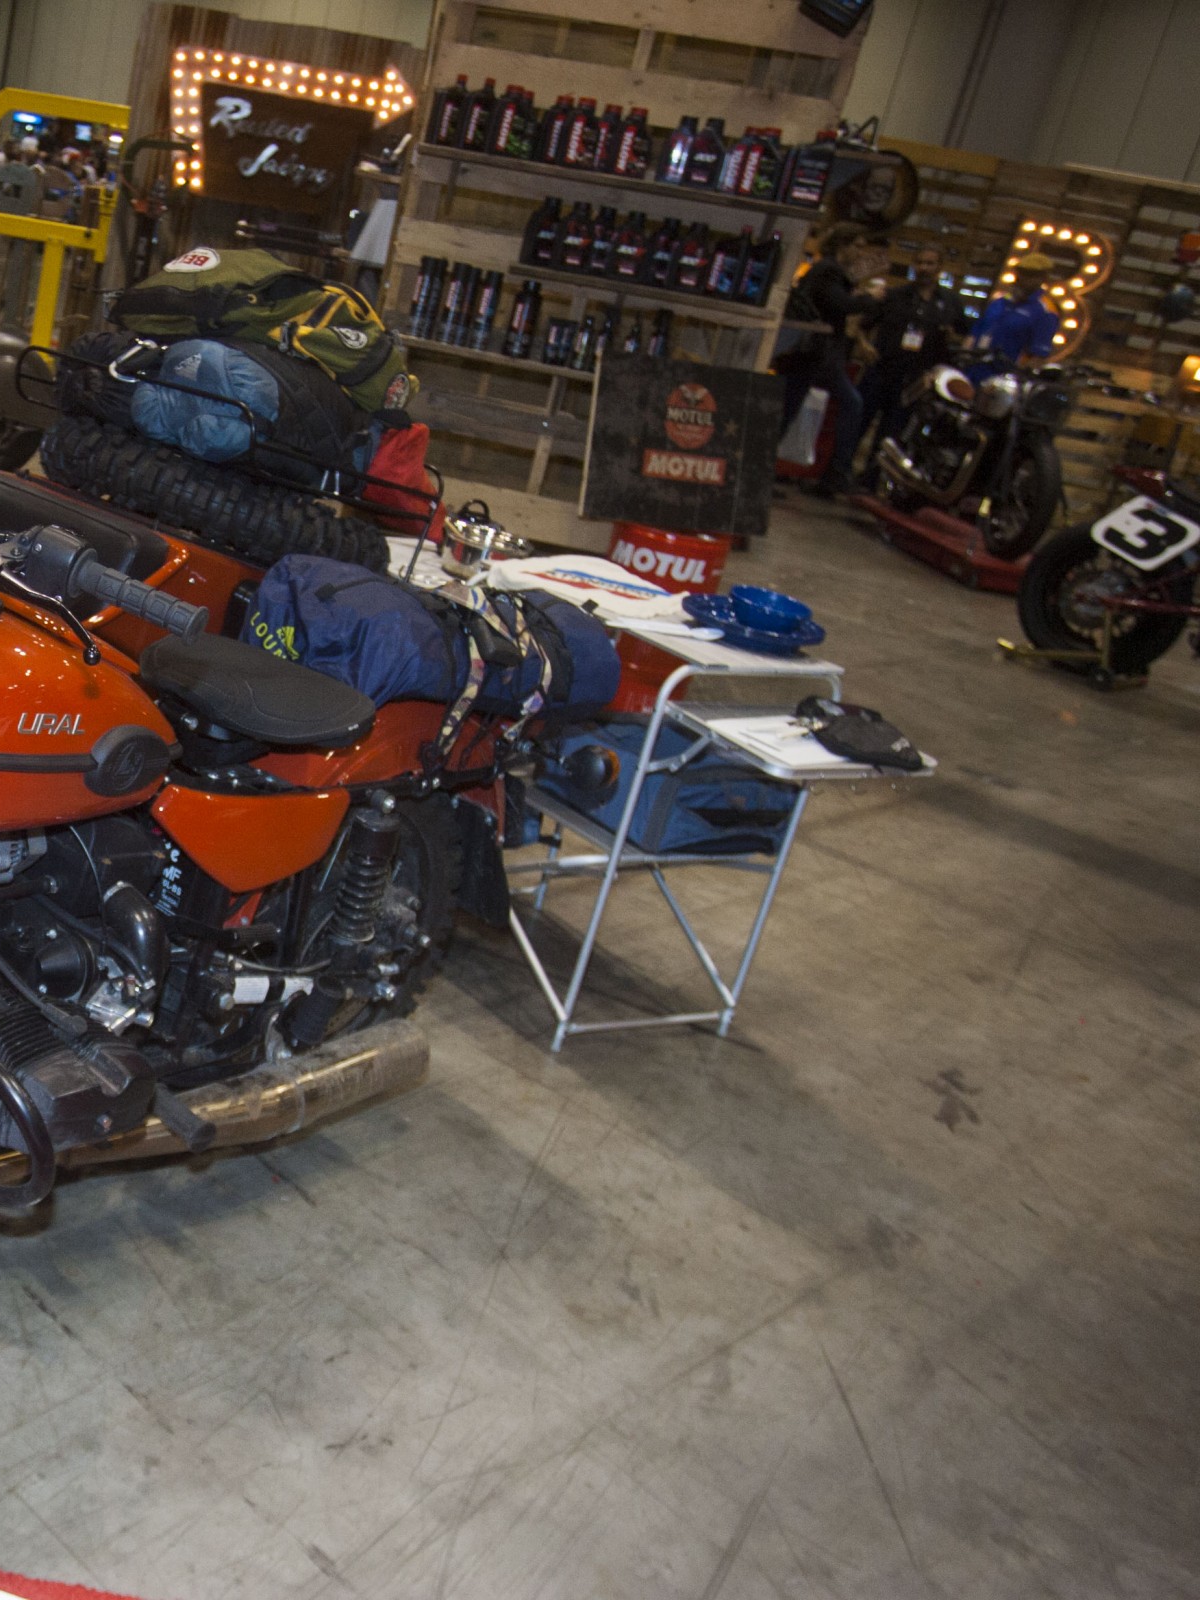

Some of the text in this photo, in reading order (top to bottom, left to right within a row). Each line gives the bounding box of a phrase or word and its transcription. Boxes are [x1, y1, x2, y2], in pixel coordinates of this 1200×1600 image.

[665, 406, 714, 427] MOTUL
[646, 453, 721, 482] MOTUL
[1102, 507, 1189, 561] 3
[611, 540, 707, 584] MOTUL
[17, 712, 86, 735] URAL
